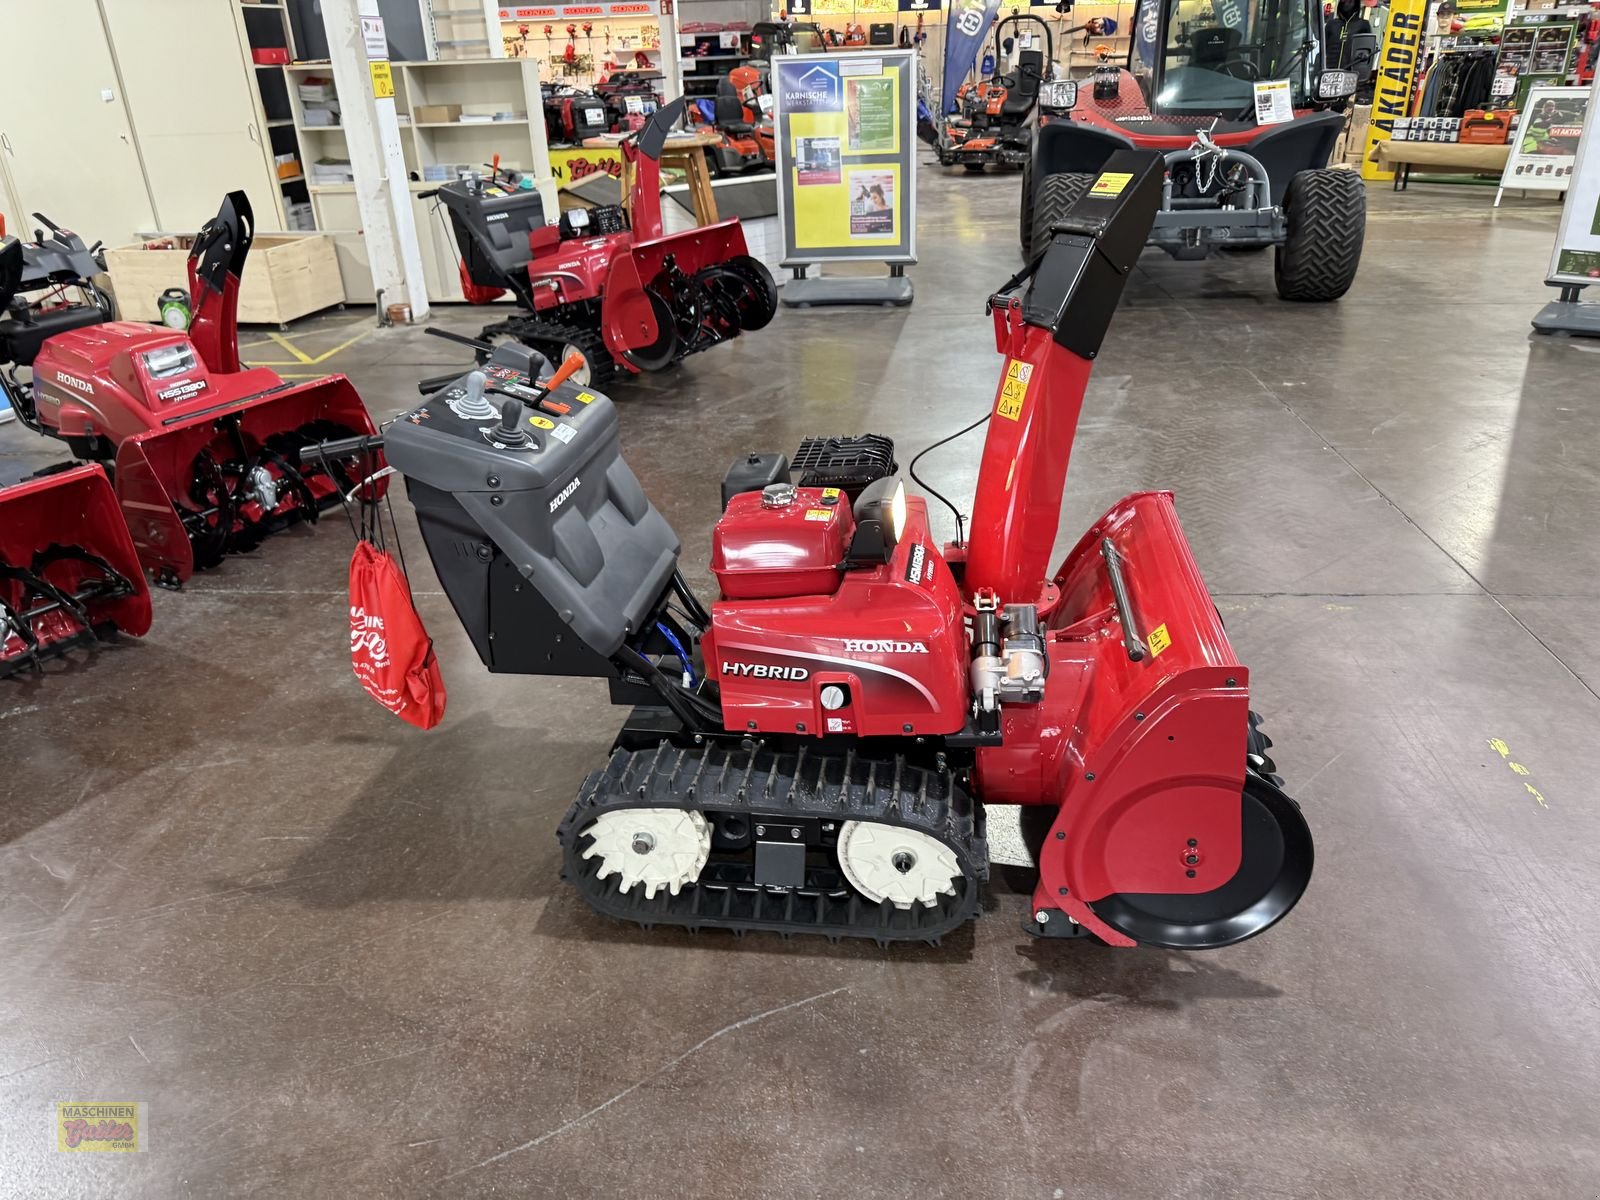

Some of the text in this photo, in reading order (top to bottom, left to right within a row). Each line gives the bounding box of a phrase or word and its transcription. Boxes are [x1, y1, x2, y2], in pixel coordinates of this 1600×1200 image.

[785, 91, 828, 100] KARNISCHE
[566, 157, 621, 182] Gaile
[56, 371, 95, 395] HONDA
[549, 476, 581, 513] HONDA
[843, 639, 930, 654] HONDA
[722, 661, 809, 681] HYBRID
